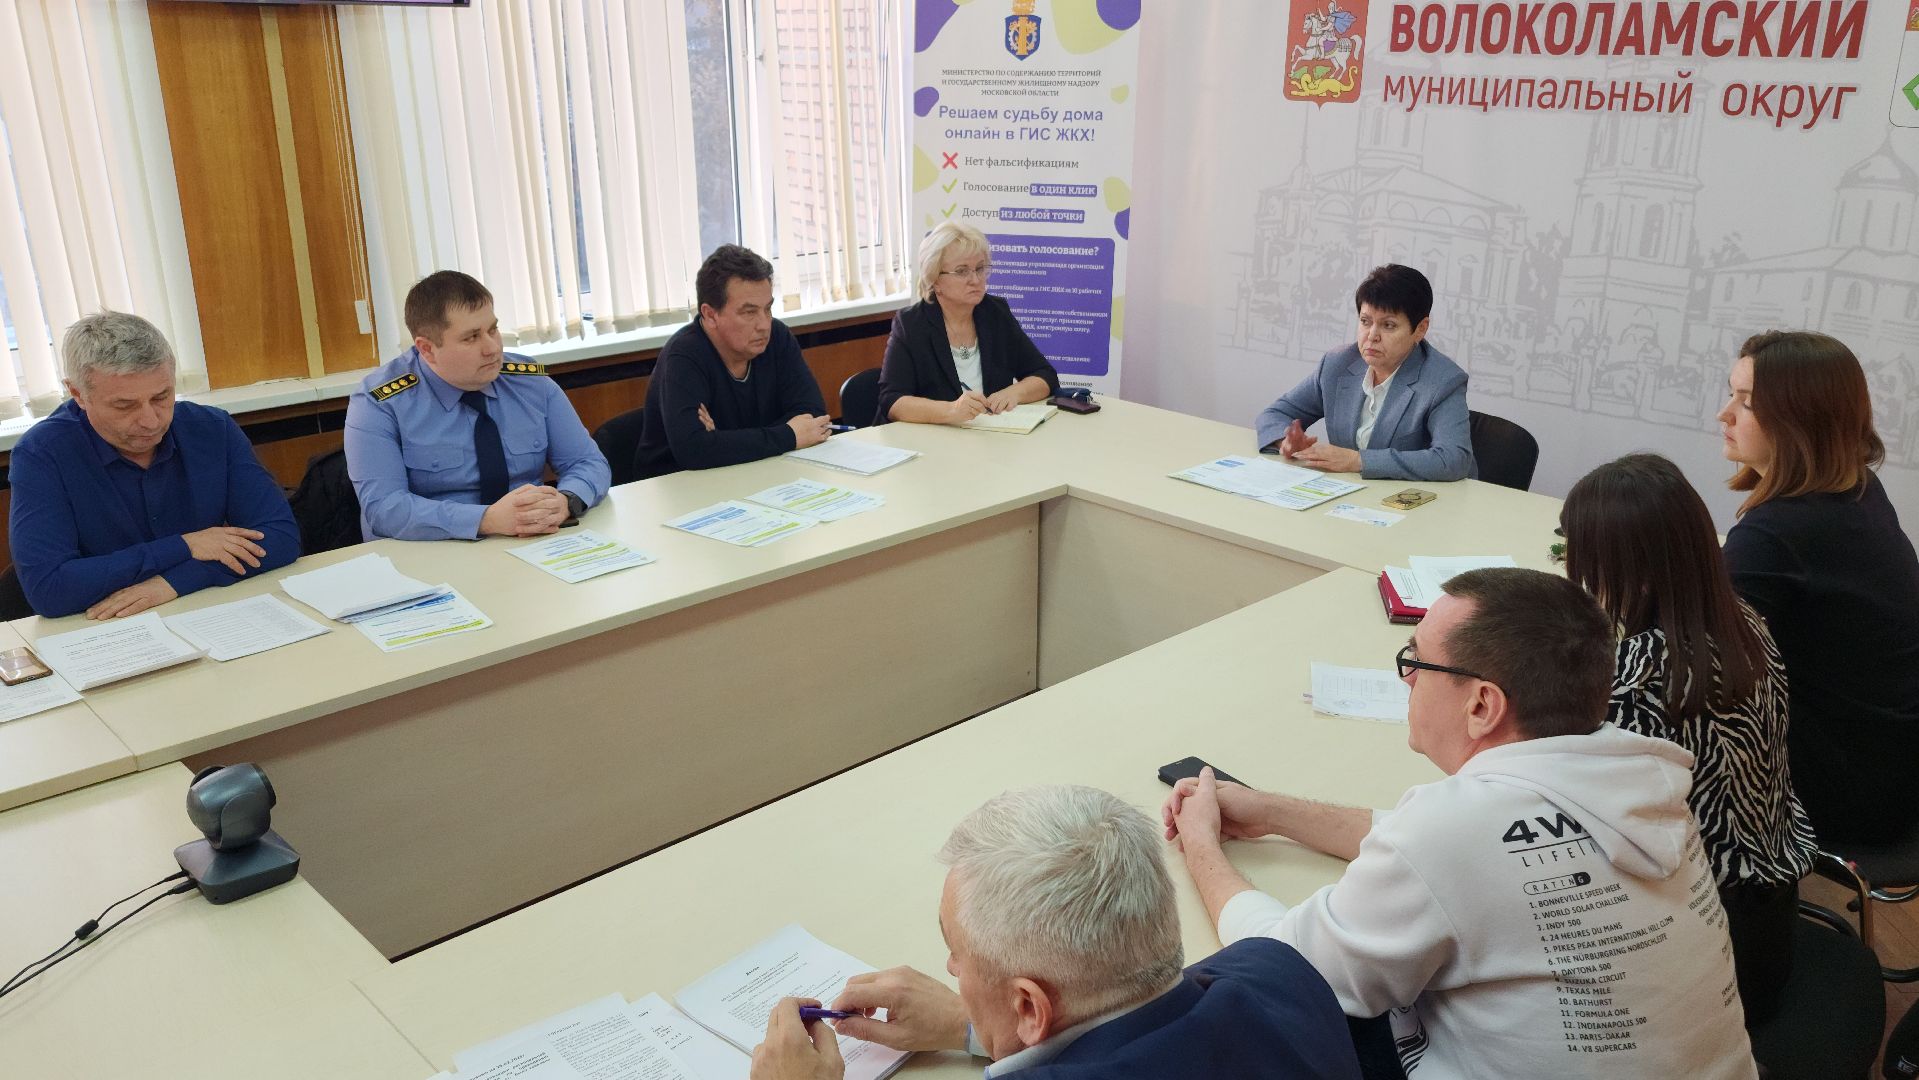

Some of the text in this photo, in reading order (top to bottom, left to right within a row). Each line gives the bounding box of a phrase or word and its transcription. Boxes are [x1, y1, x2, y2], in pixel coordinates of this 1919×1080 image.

[942, 69, 994, 77] МИНИСТЕРСТВО
[947, 80, 1016, 88] ГОСУДАРСТВЕННОМУ
[1017, 80, 1066, 88] ЖИЛИЩНОМУ
[1027, 89, 1059, 97] ОБЛАСТИ
[1384, 70, 1857, 130] муниципальный округ
[939, 105, 1103, 123] Решаем судьбу дома
[945, 127, 1095, 142] онлайн в ГИС ЖКХ!
[965, 156, 1079, 169] Нет фальсификациям
[963, 181, 1029, 193] Голосование
[1039, 186, 1067, 196] один
[1068, 186, 1096, 196] клик
[962, 207, 1084, 221] Доступ из любой точки
[988, 244, 1100, 257] изовать голосование?
[1502, 812, 1584, 844] 4W
[1532, 875, 1585, 893] RATING
[1538, 893, 1584, 908] BONNEVILLE
[1584, 888, 1604, 899] SPEED
[1603, 883, 1622, 894] WEEK
[1533, 893, 1630, 921] 2. WORLD SOLAR CHALLENGE
[1546, 922, 1566, 931] INDY
[1567, 918, 1581, 927] 500
[1550, 934, 1560, 942] 24
[1561, 929, 1591, 940] HEURES
[1603, 922, 1623, 933] MANS
[1544, 946, 1552, 954] 5.
[1553, 943, 1576, 953] PIKES
[1577, 940, 1597, 949] PEAK
[1598, 928, 1648, 947] INTERNATIONAL
[1548, 957, 1556, 965] 6.
[1556, 955, 1572, 964] THE
[1626, 932, 1668, 952] NORDSCHLEIFE
[1561, 965, 1597, 976] DAYTONA
[1598, 963, 1612, 971] 500
[1598, 971, 1626, 984] CIRCUIT
[1565, 986, 1591, 995] TEXAS
[1592, 986, 1612, 995] MILE
[1558, 997, 1613, 1007] 10. BATHURST
[1560, 1007, 1631, 1018] 11. FORMULA ONE
[1562, 1016, 1648, 1030] 12. INDIANAPOLIS 500
[1564, 1031, 1631, 1041] 13. PARIS-DAKAR
[1567, 1042, 1637, 1053] 14. V8 SUPERCARS
